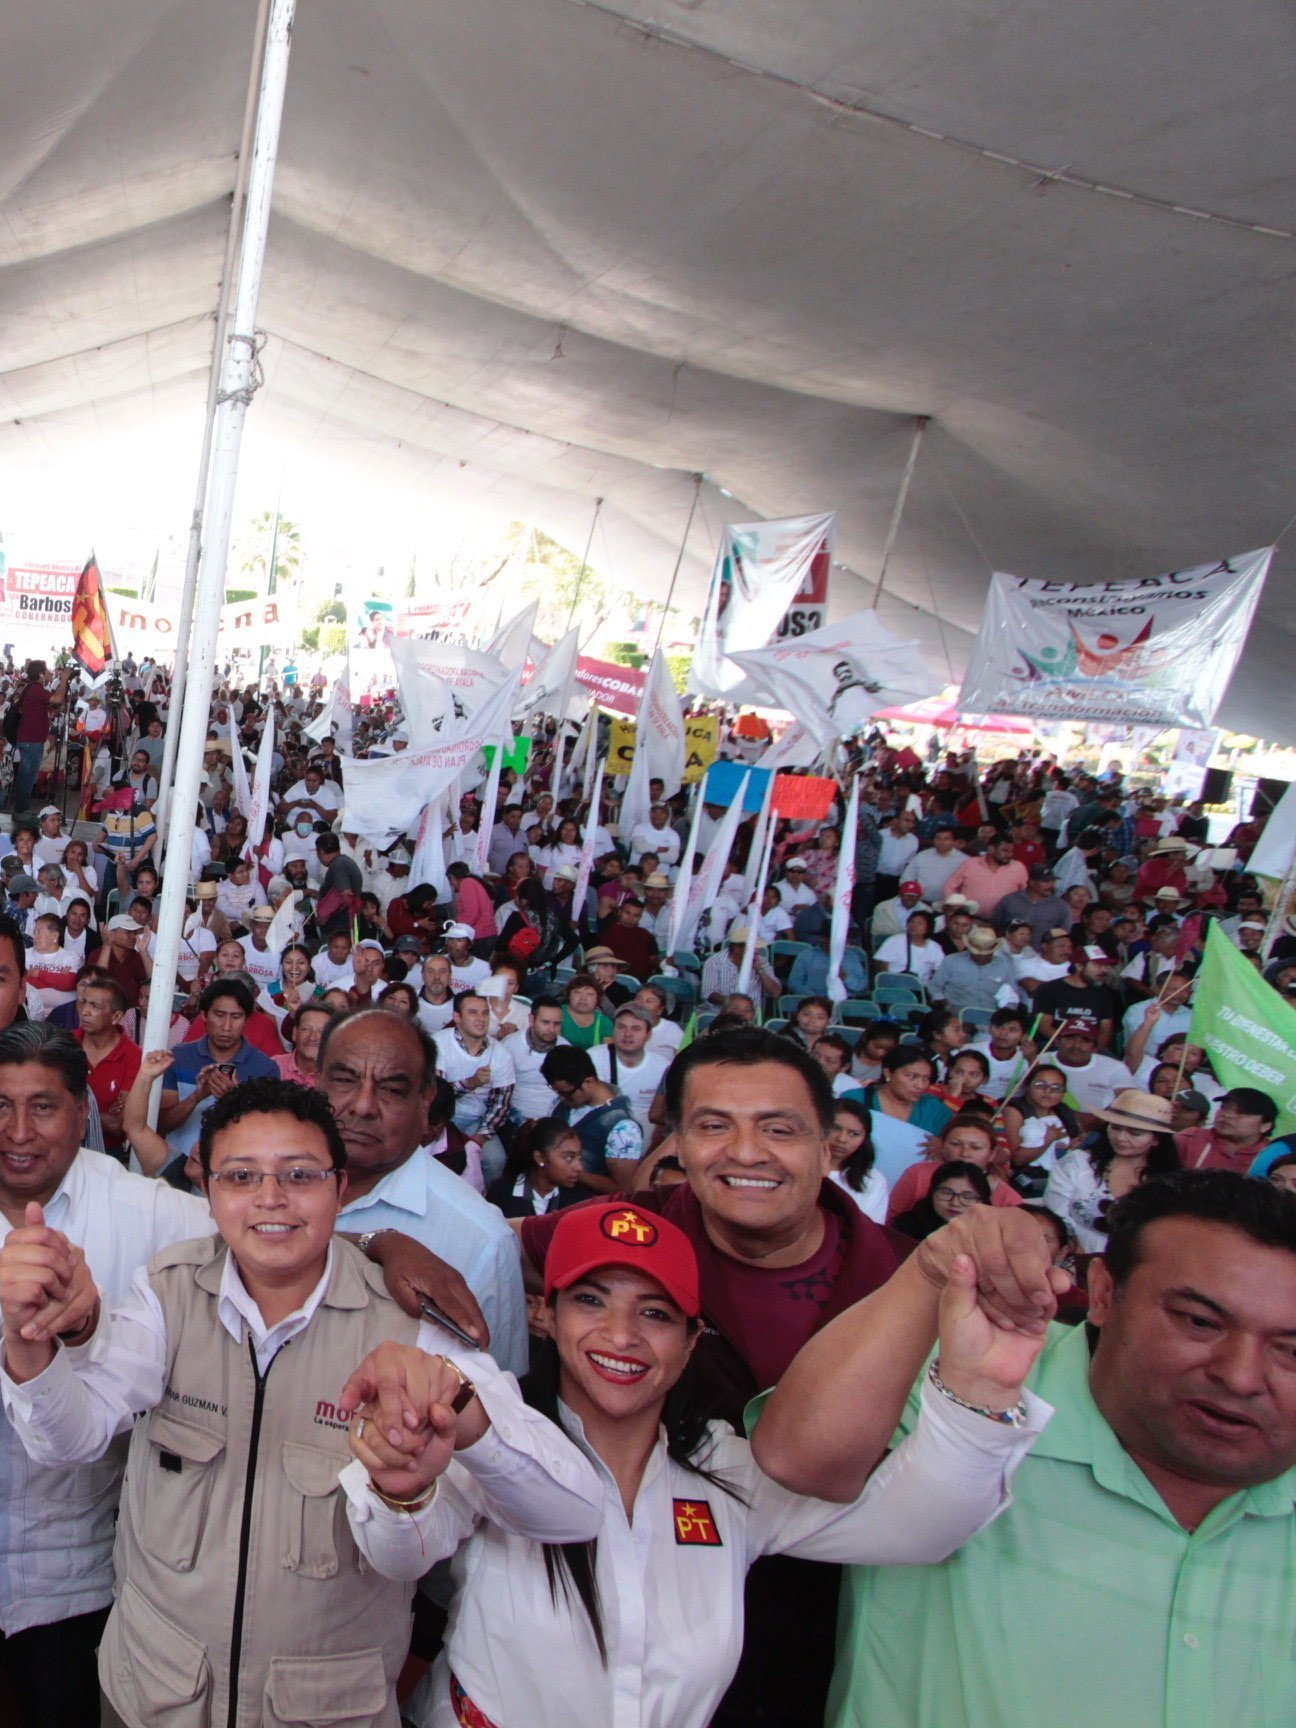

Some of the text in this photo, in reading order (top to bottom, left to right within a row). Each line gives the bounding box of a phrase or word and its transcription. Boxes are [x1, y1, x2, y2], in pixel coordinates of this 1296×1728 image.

[15, 571, 75, 593] TEPEACA
[610, 1219, 650, 1242] PT
[182, 1394, 218, 1413] GUZMAN
[314, 1416, 323, 1425] La
[677, 1516, 709, 1540] PT
